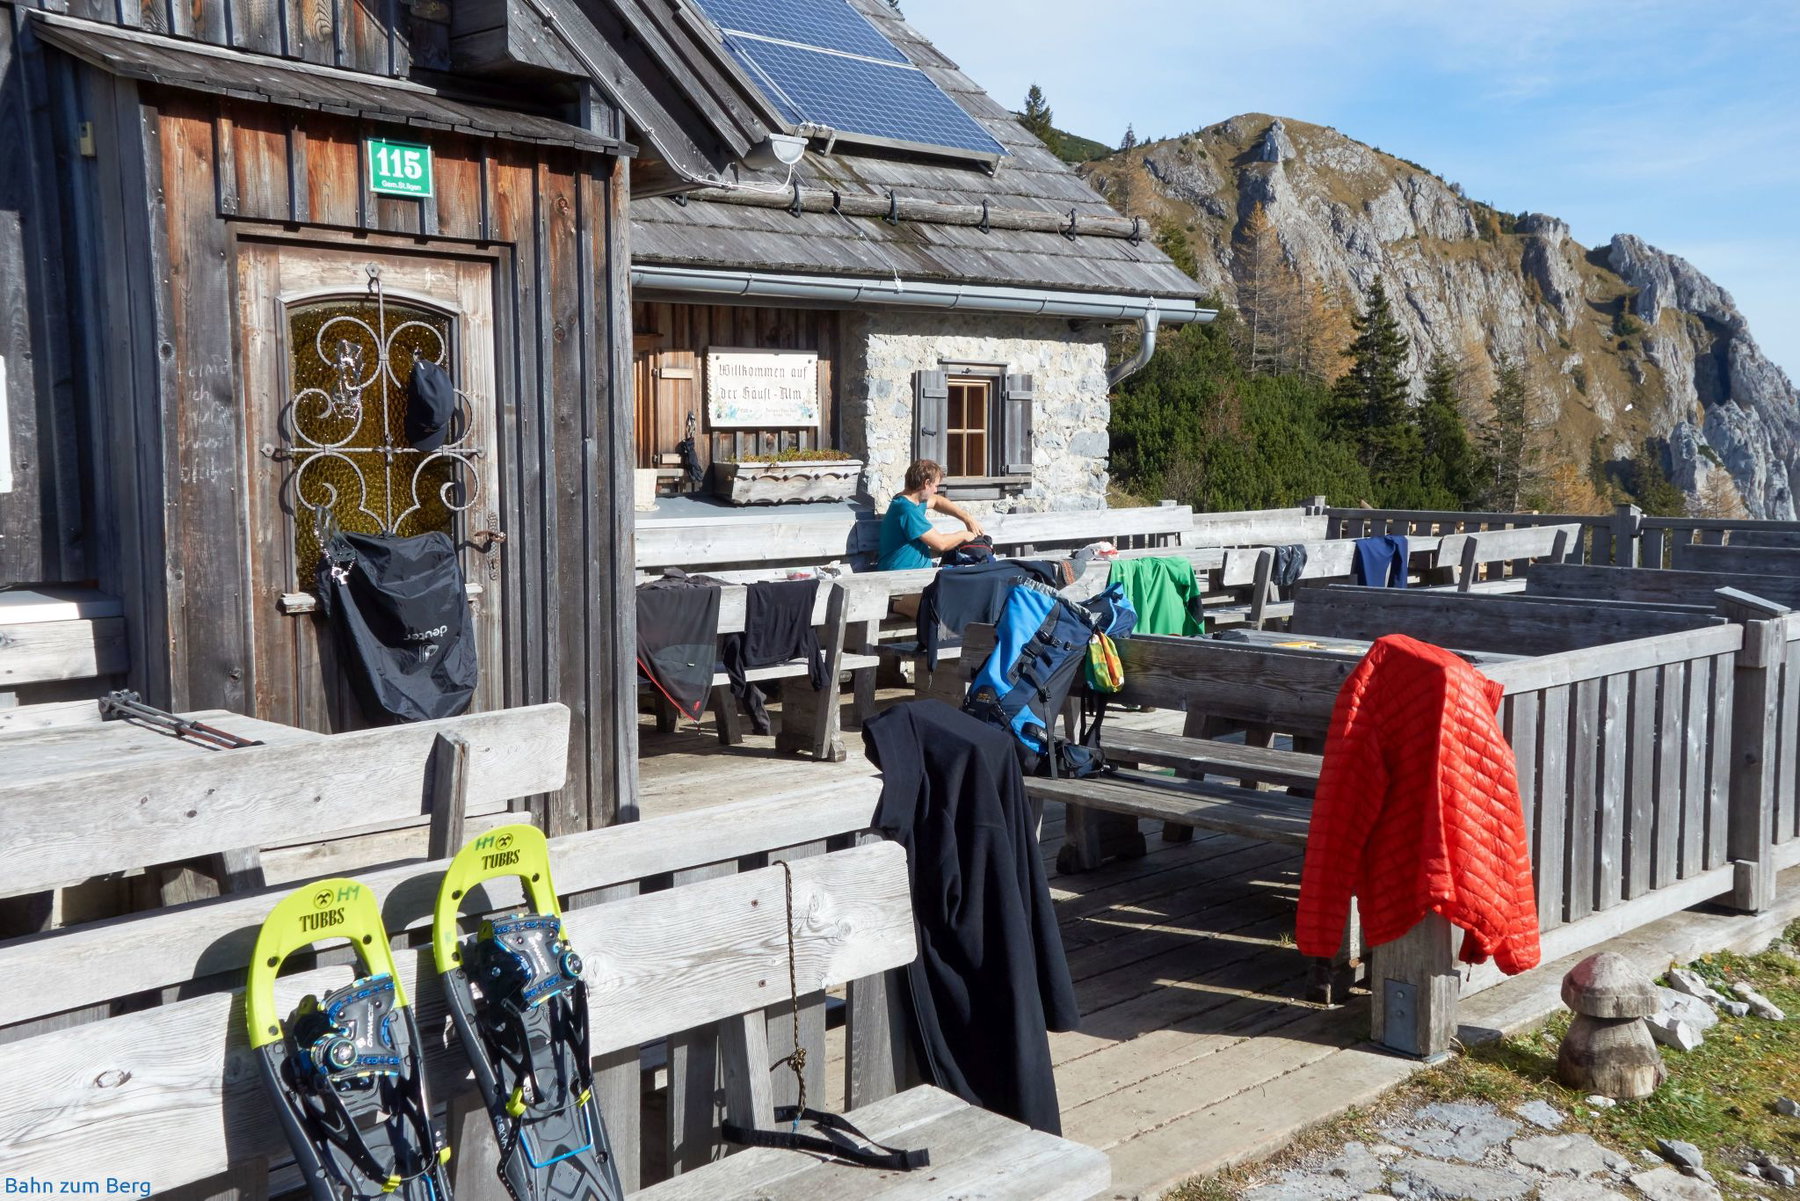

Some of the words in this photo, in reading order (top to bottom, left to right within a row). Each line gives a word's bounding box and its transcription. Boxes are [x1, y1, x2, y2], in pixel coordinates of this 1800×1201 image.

[376, 147, 422, 179] 115
[719, 364, 785, 378] Willkommen
[790, 367, 807, 379] auf
[721, 387, 737, 399] der
[403, 625, 448, 640] deuter
[481, 849, 521, 870] TUBBS
[299, 907, 345, 932] TUBBS
